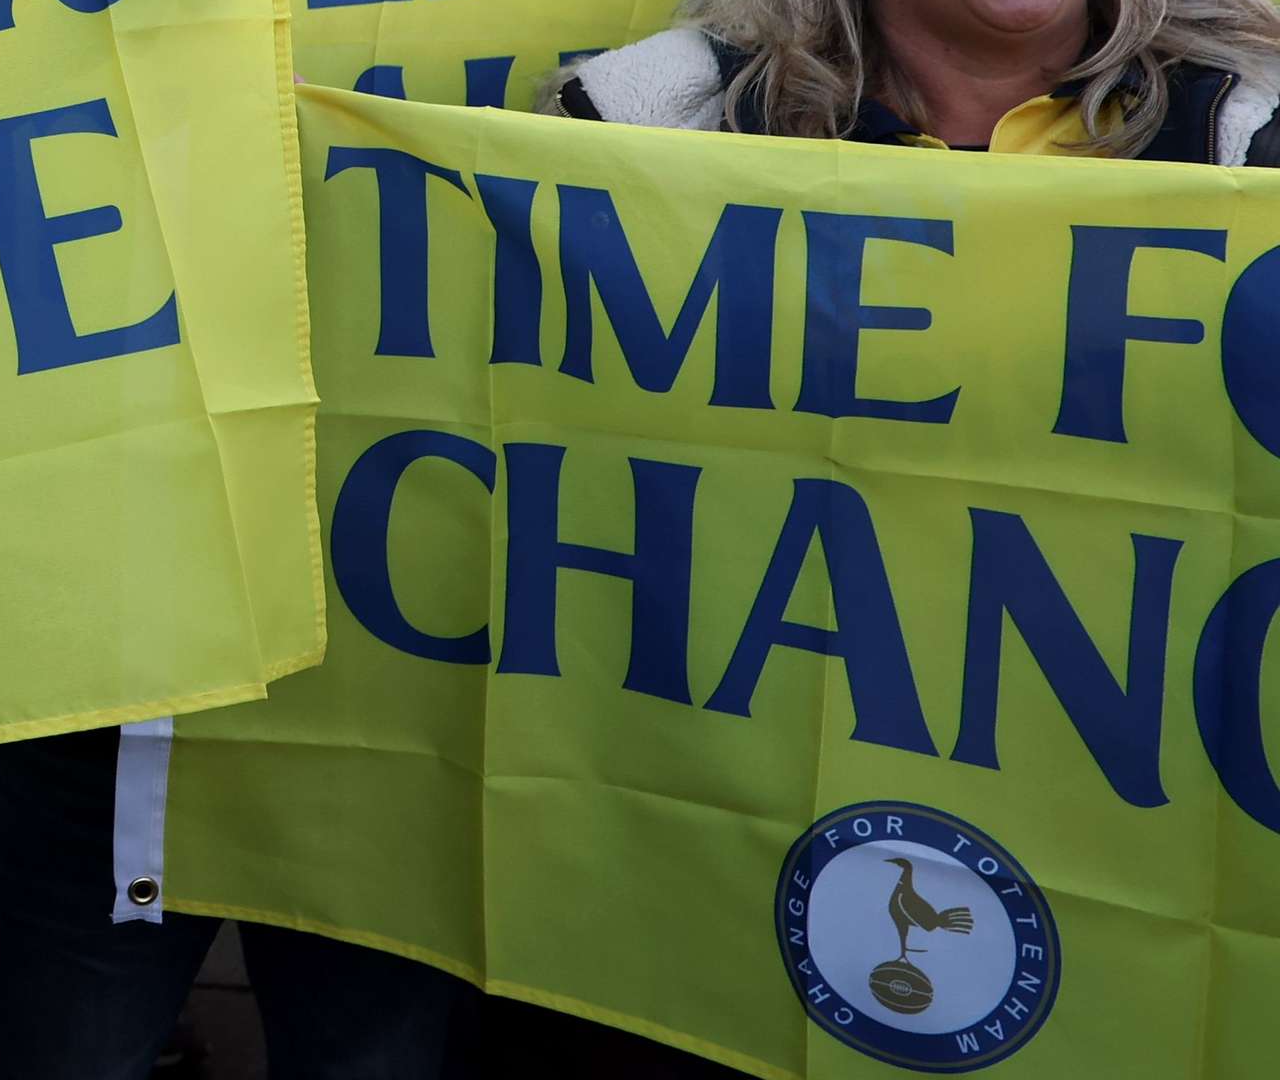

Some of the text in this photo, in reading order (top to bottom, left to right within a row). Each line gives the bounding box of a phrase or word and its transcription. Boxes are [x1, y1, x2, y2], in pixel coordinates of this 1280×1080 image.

[323, 145, 962, 425] TIME
[788, 815, 1043, 1054] CHANGE FOR TOTTENHAM
